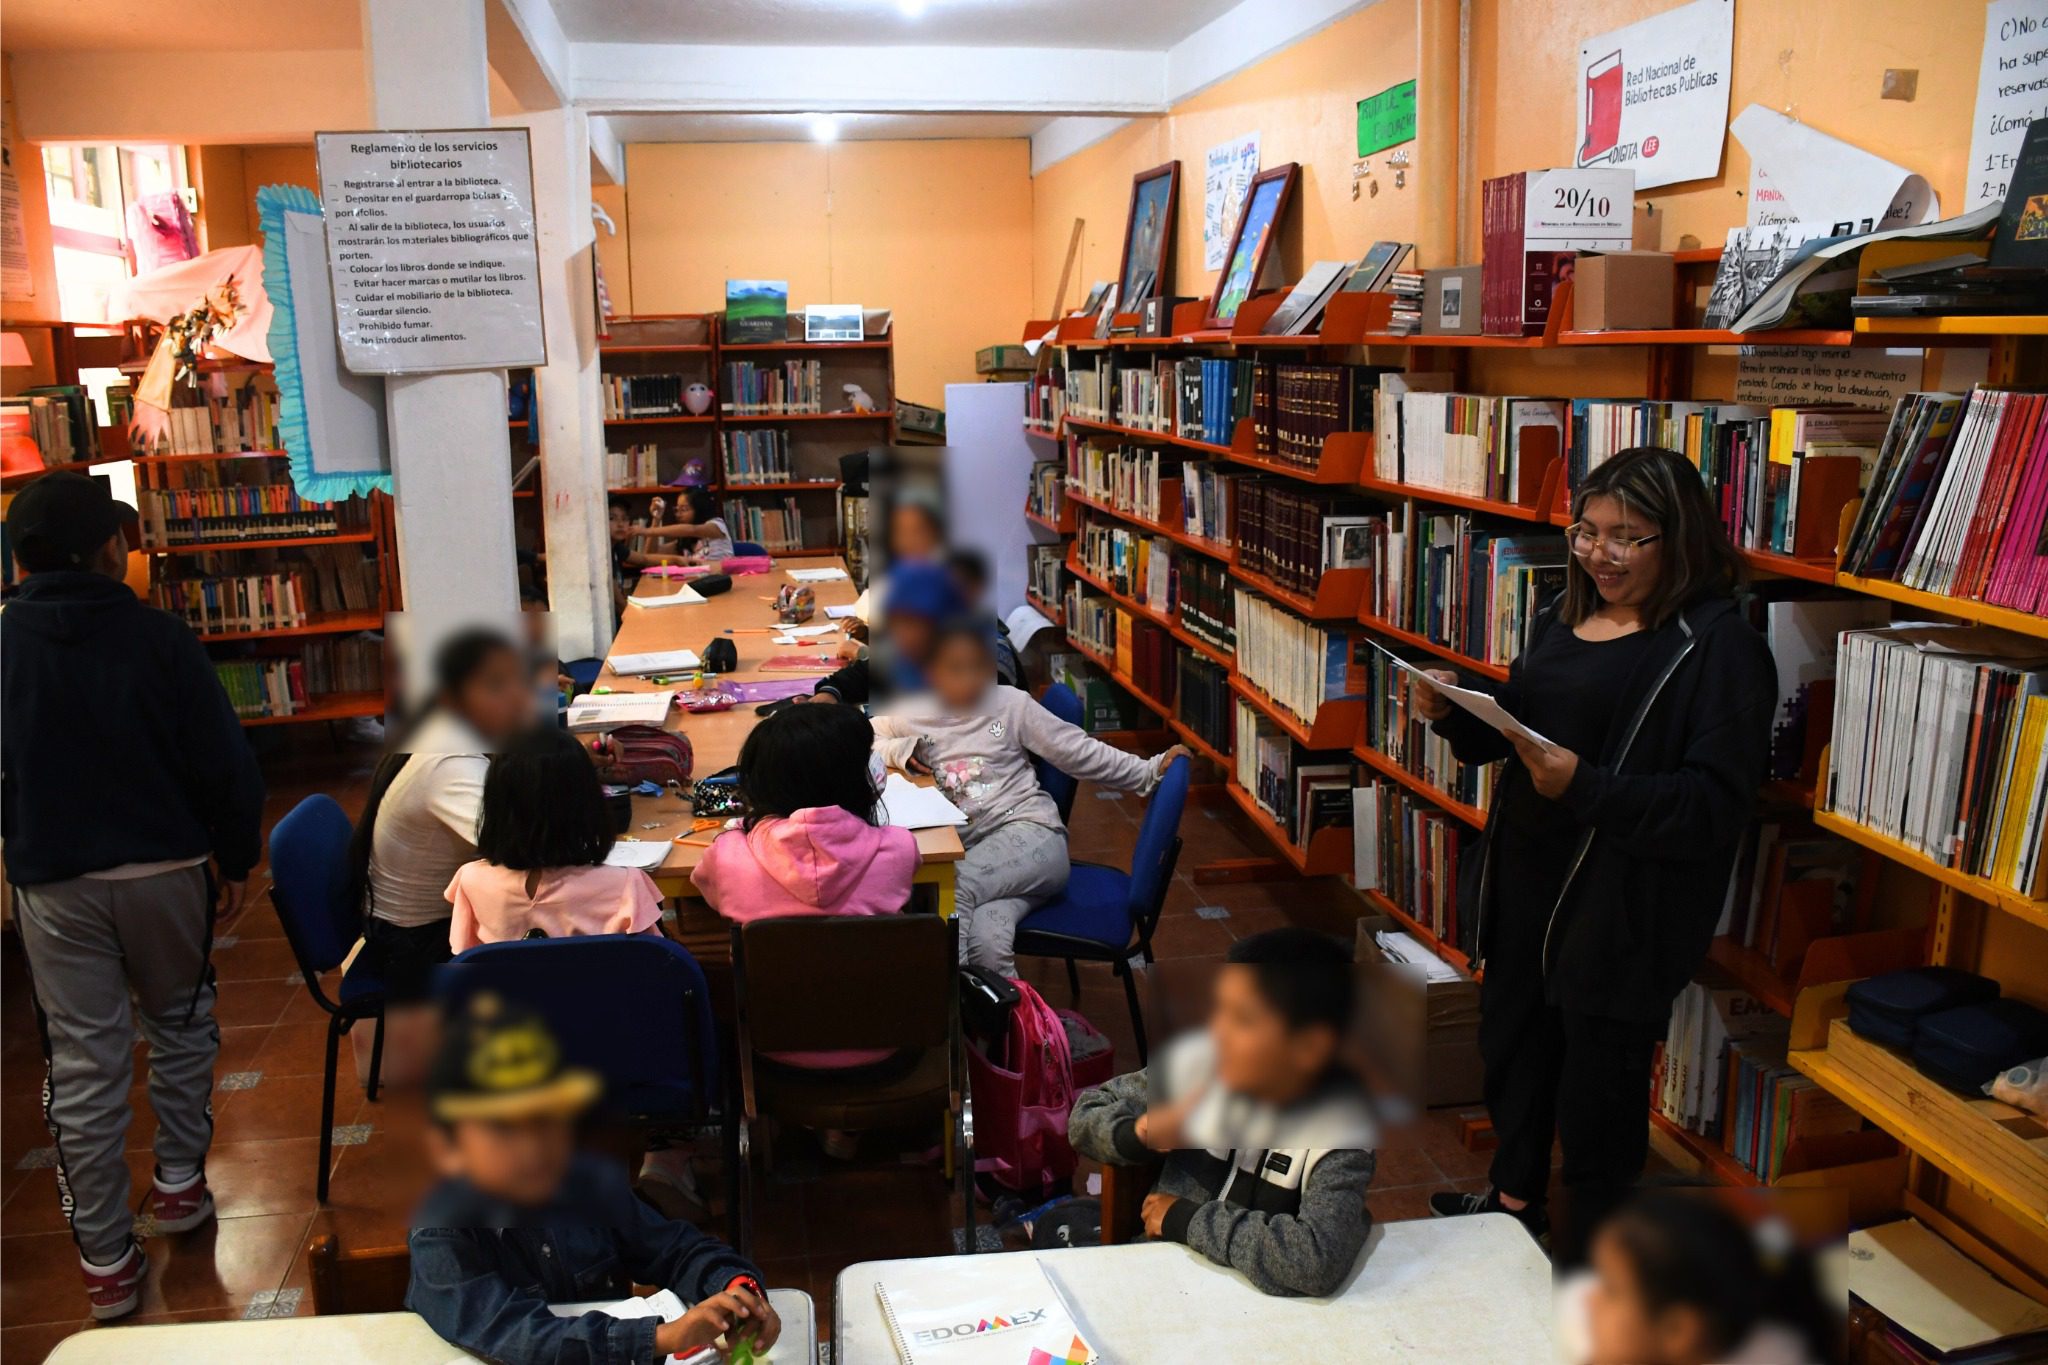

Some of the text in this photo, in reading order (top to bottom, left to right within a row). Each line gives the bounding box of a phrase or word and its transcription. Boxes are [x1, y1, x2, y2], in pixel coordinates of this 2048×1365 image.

[1626, 54, 1696, 87] Red Nacional de
[2000, 57, 2017, 71] ha
[1625, 72, 1718, 106] Bibliotecas Publicas
[351, 142, 498, 155] Reglamento de los servicios
[1644, 139, 1656, 152] LEE
[1612, 142, 1638, 164] DIGITA
[391, 159, 462, 169] bibliotecarios
[344, 180, 394, 189] Registrarse
[455, 178, 501, 186] biblioteca.
[346, 195, 389, 204] Depositar
[405, 194, 413, 202] el
[416, 193, 470, 203] guardarropa
[473, 192, 500, 200] bolsas
[1554, 188, 1610, 217] 20/10
[349, 223, 357, 231] Al
[360, 223, 379, 231] salir
[405, 221, 451, 231] biblioteca,
[468, 219, 505, 228] usuarios
[338, 233, 528, 245] mostrarán los materiales bibliográficos que
[1591, 241, 1597, 249] 2
[339, 252, 373, 261] porten.
[350, 265, 383, 273] Colocar
[386, 264, 398, 272] los
[401, 263, 425, 272] libros
[427, 262, 455, 270] donde
[470, 260, 505, 270] indique.
[354, 279, 379, 288] Evitar
[382, 278, 406, 287] hacer
[409, 278, 439, 286] marcas
[450, 275, 482, 284] mutilar
[485, 274, 497, 282] los
[499, 273, 526, 282] libros.
[356, 288, 512, 302] Cuidar el mobiliario de la biblioteca.
[357, 306, 431, 316] Guardar silencio.
[359, 321, 432, 330] Prohibido fumar.
[376, 335, 418, 344] introducir
[421, 333, 466, 342] alimentos.
[1814, 364, 1831, 376] libro
[1851, 368, 1860, 378] se
[1864, 369, 1905, 382] encuentra
[1801, 382, 1810, 390] se
[1814, 381, 1833, 393] haya
[1838, 381, 1846, 393] la
[913, 1308, 1047, 1343] EDOMEX
